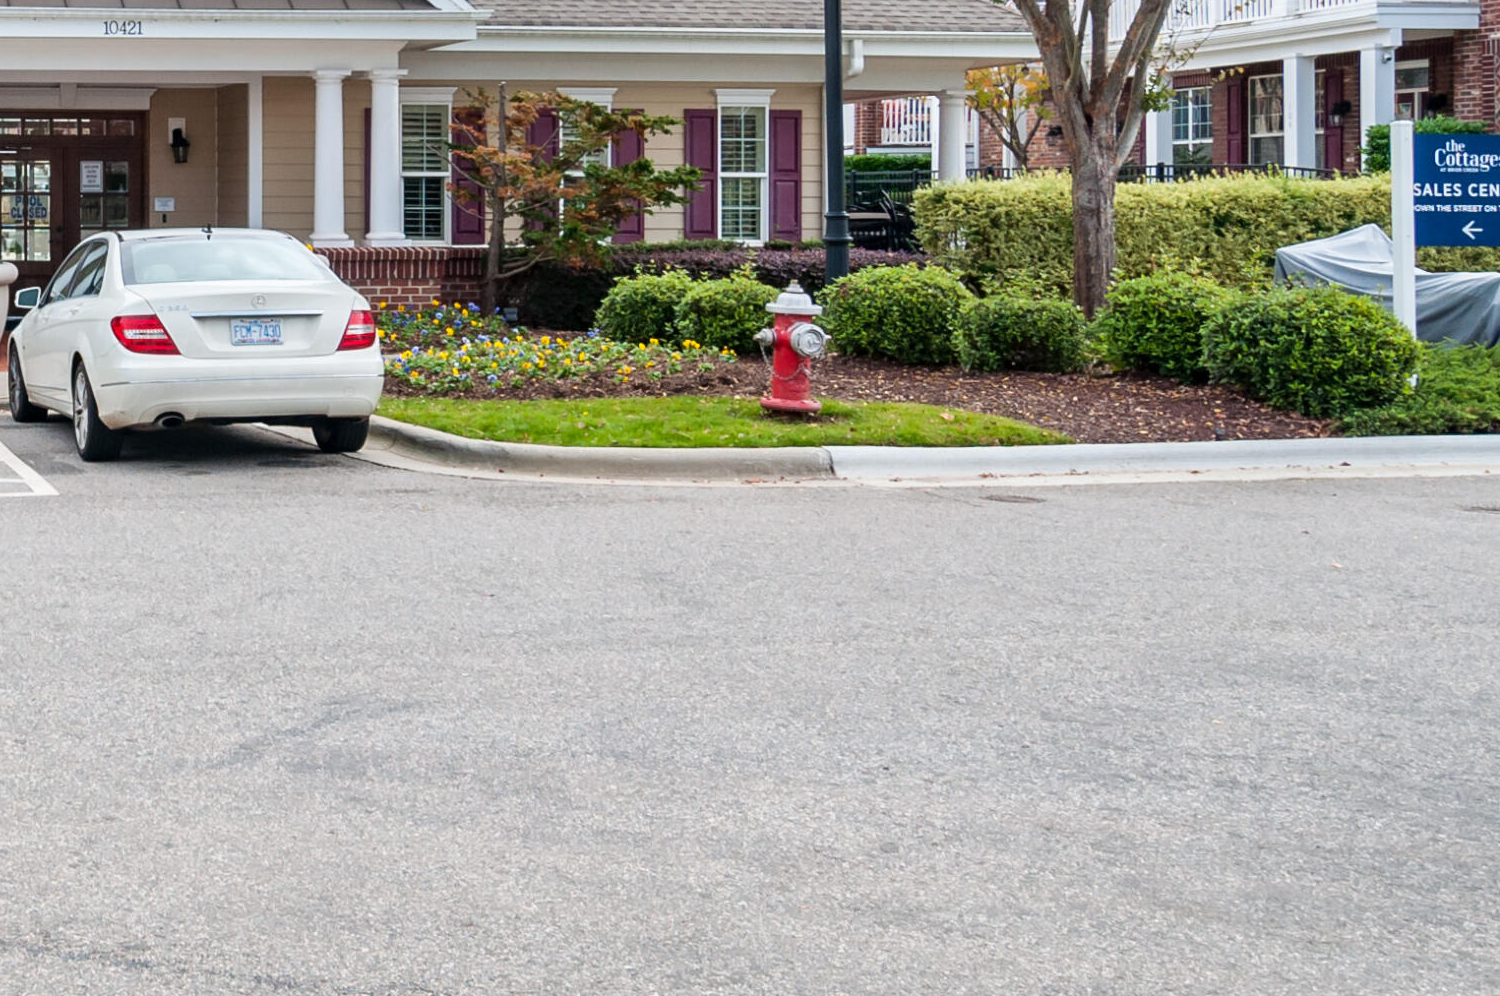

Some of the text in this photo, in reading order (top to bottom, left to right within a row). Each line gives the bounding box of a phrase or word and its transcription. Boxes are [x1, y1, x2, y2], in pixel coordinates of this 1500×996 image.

[103, 20, 143, 35] 10421
[1445, 139, 1466, 152] the
[1434, 148, 1500, 173] Cottage
[1413, 183, 1462, 197] SALES
[16, 195, 42, 206] POL
[11, 206, 47, 219] CLSED
[1413, 204, 1435, 212] OWN
[1436, 204, 1452, 212] THE
[1453, 204, 1483, 212] STREET
[1484, 204, 1497, 212] ON
